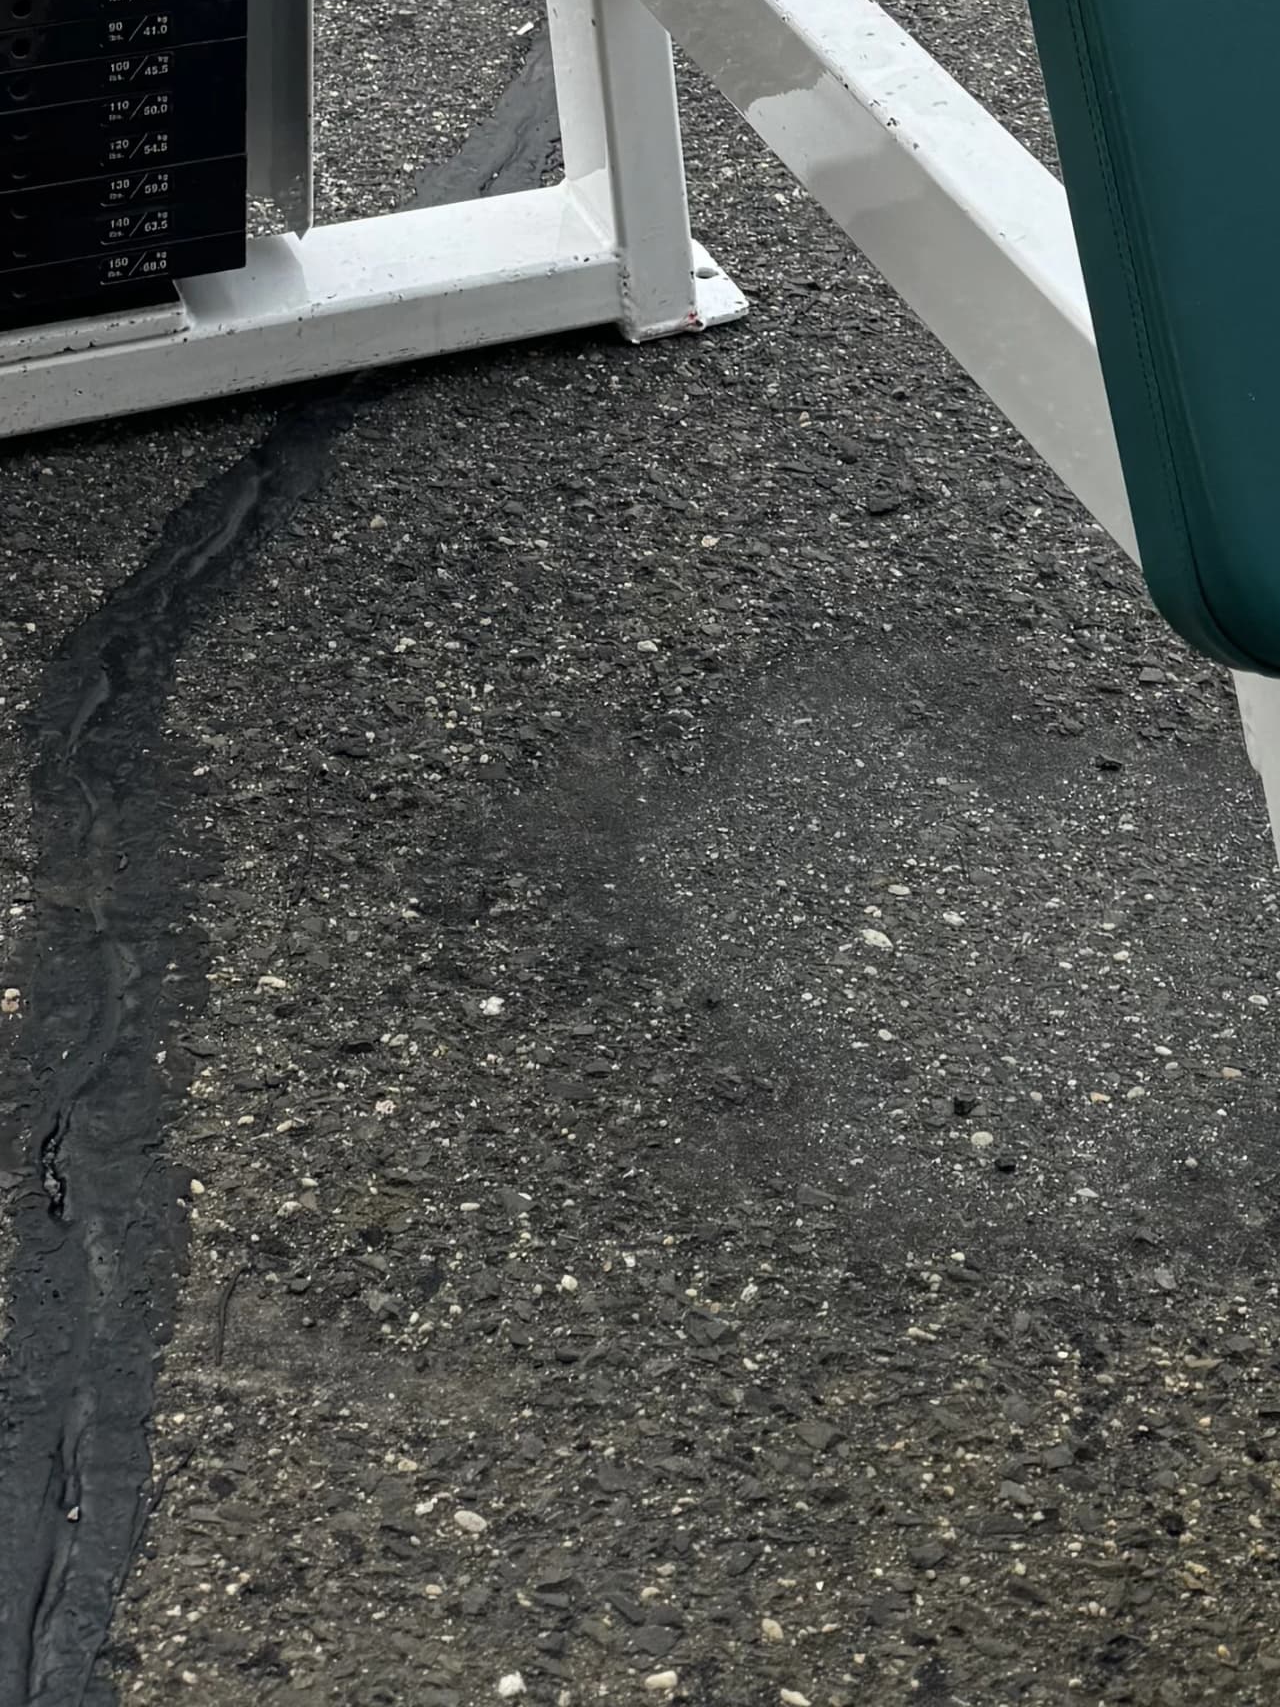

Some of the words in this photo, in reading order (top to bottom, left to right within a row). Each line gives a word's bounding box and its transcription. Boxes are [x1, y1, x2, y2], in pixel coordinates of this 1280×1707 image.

[109, 21, 123, 32] 90
[110, 61, 130, 72] 100
[110, 100, 129, 112] 110
[110, 139, 129, 150] 120
[110, 179, 130, 190] 130
[110, 217, 130, 229] 140
[110, 257, 129, 269] 150
